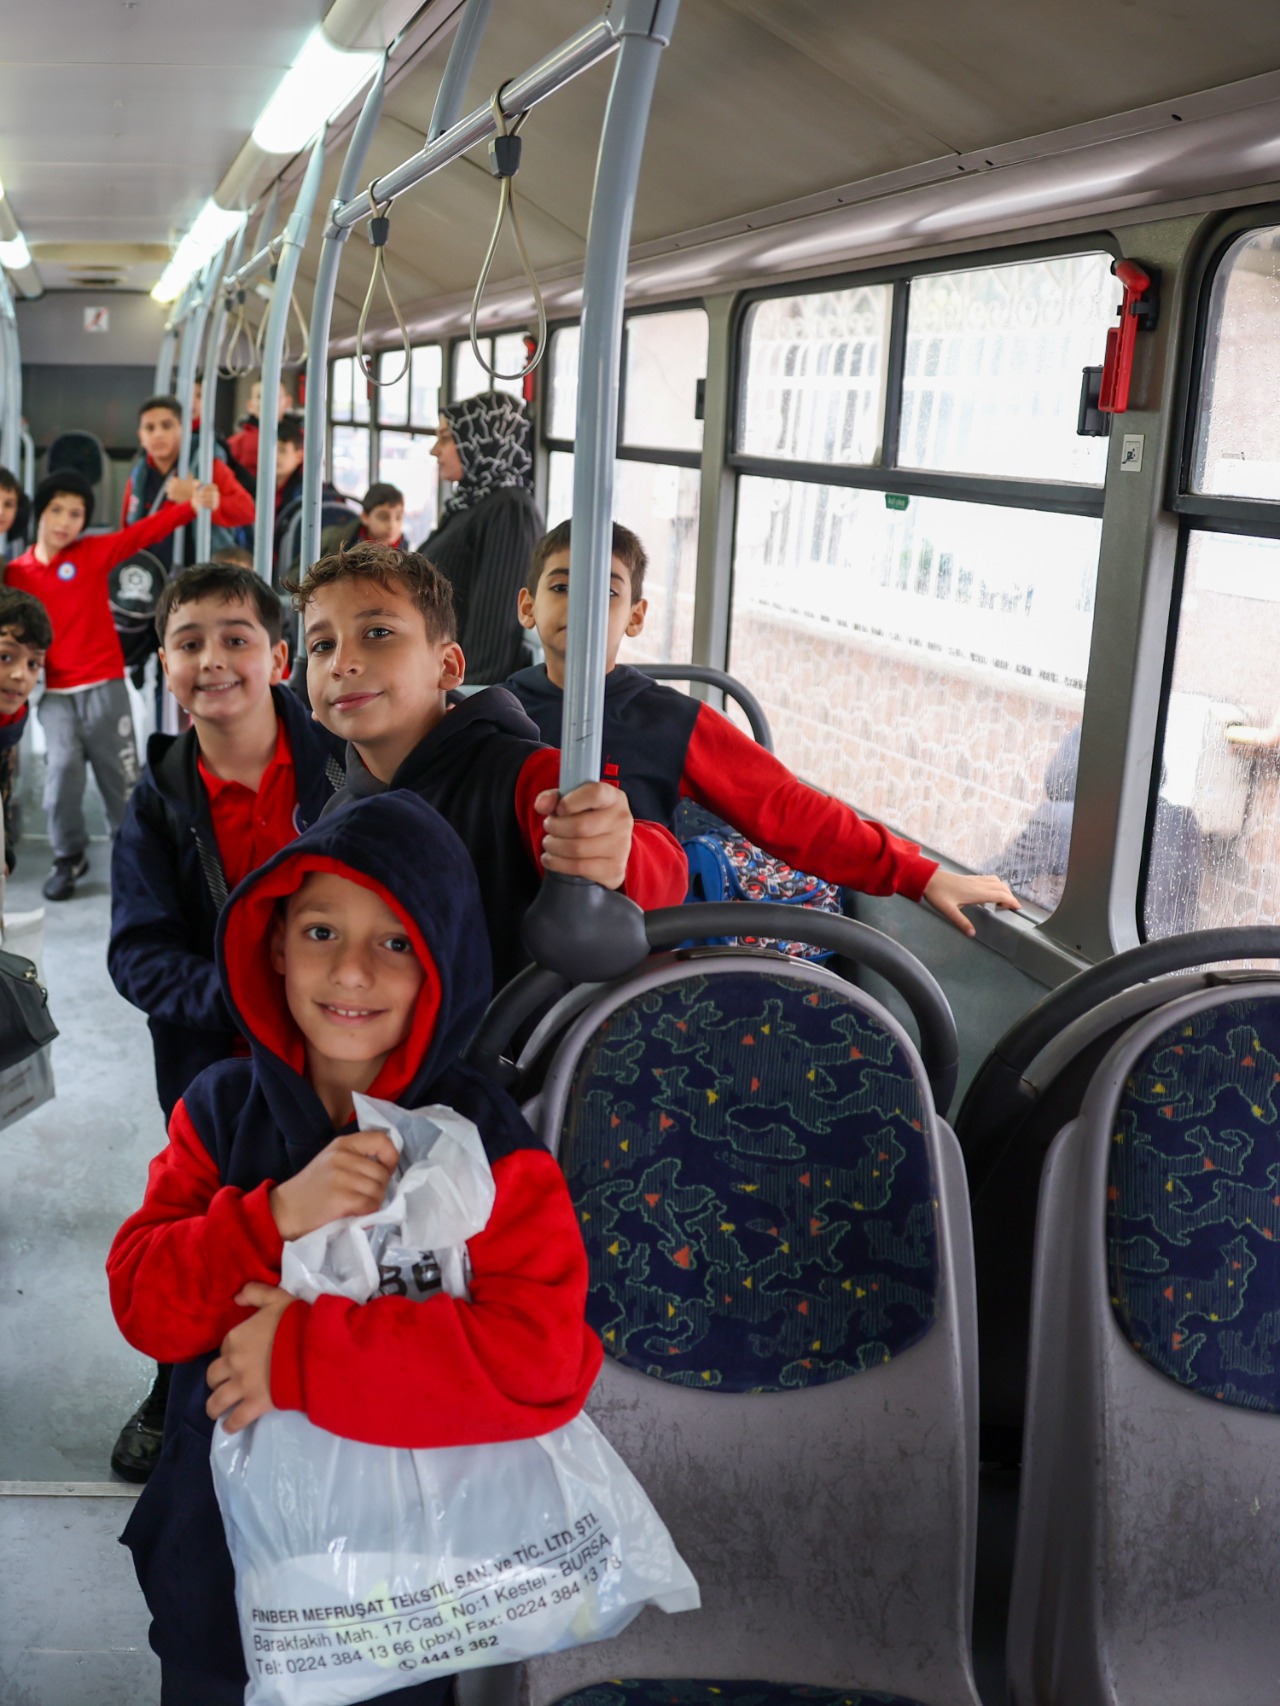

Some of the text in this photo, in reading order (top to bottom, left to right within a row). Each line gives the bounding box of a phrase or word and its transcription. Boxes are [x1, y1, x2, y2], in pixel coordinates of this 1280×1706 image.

[252, 1608, 299, 1624] FİNBER
[303, 1599, 384, 1622] MEFRUŞAT
[454, 1565, 492, 1589] SAN.
[494, 1558, 512, 1573] ve
[513, 1543, 544, 1564] TİC.
[544, 1530, 575, 1552] LTD.
[254, 1634, 332, 1653] Barakfakih
[335, 1629, 378, 1646] Mah.
[451, 1594, 490, 1619] No:1
[495, 1573, 547, 1604] Kestel
[559, 1533, 612, 1577] BURSA
[255, 1658, 283, 1676] Tel:
[286, 1656, 327, 1674] 0224
[332, 1650, 363, 1666] 384
[369, 1645, 389, 1660] 13
[393, 1640, 414, 1656] 66
[420, 1627, 461, 1651] (pbx)
[465, 1615, 503, 1635] Fax:
[506, 1596, 547, 1621] 0224
[551, 1581, 581, 1605] 384
[583, 1566, 599, 1586] 13
[420, 1635, 500, 1665] 444 5 362
